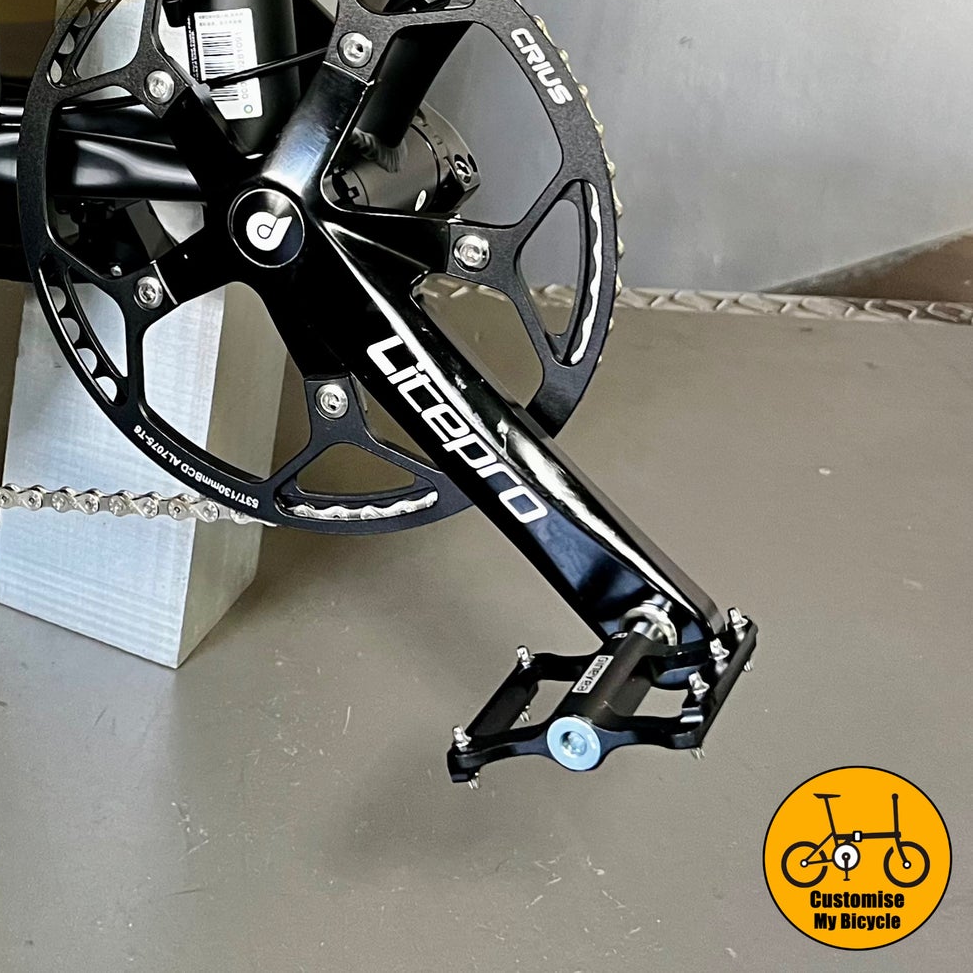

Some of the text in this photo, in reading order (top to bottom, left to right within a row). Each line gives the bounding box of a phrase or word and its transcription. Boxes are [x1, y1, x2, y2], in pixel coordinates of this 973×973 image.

[510, 27, 573, 105] CRIUS
[133, 425, 260, 510] 53T/130mmBCD AL7075-T6
[366, 334, 549, 524] Litepro
